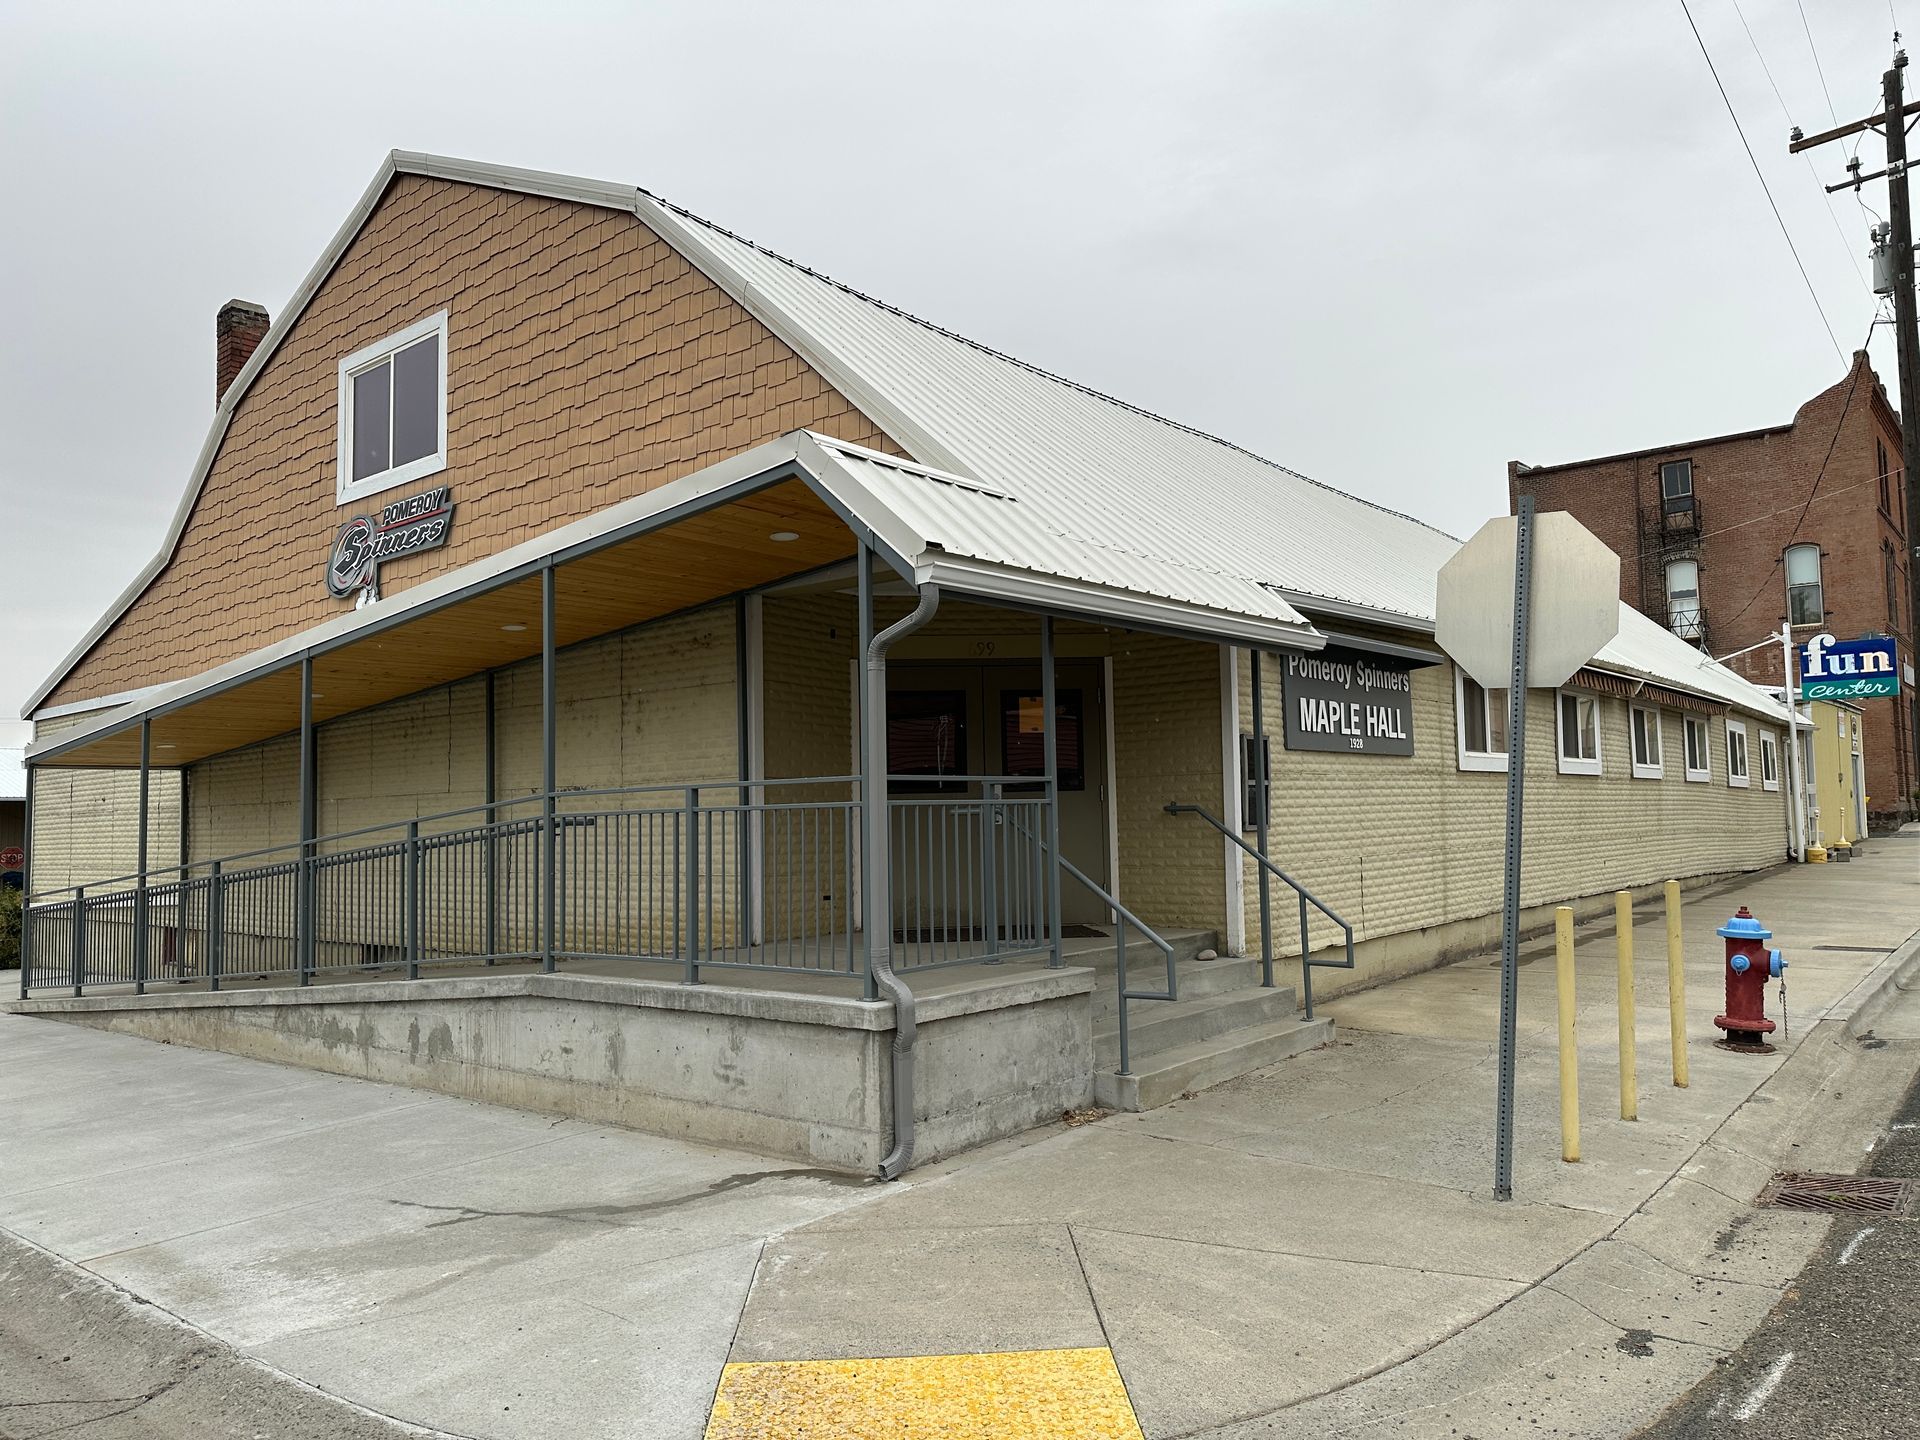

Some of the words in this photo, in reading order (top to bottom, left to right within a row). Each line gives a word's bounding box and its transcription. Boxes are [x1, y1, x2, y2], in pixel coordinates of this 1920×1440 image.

[381, 487, 443, 527] POMEROY
[333, 519, 444, 576] Spinners
[1289, 655, 1352, 690] Pomeroy
[1356, 661, 1410, 692] Spinners
[1802, 633, 1893, 677] fun
[1300, 697, 1361, 734] MAPLE
[1366, 705, 1406, 739] HALL
